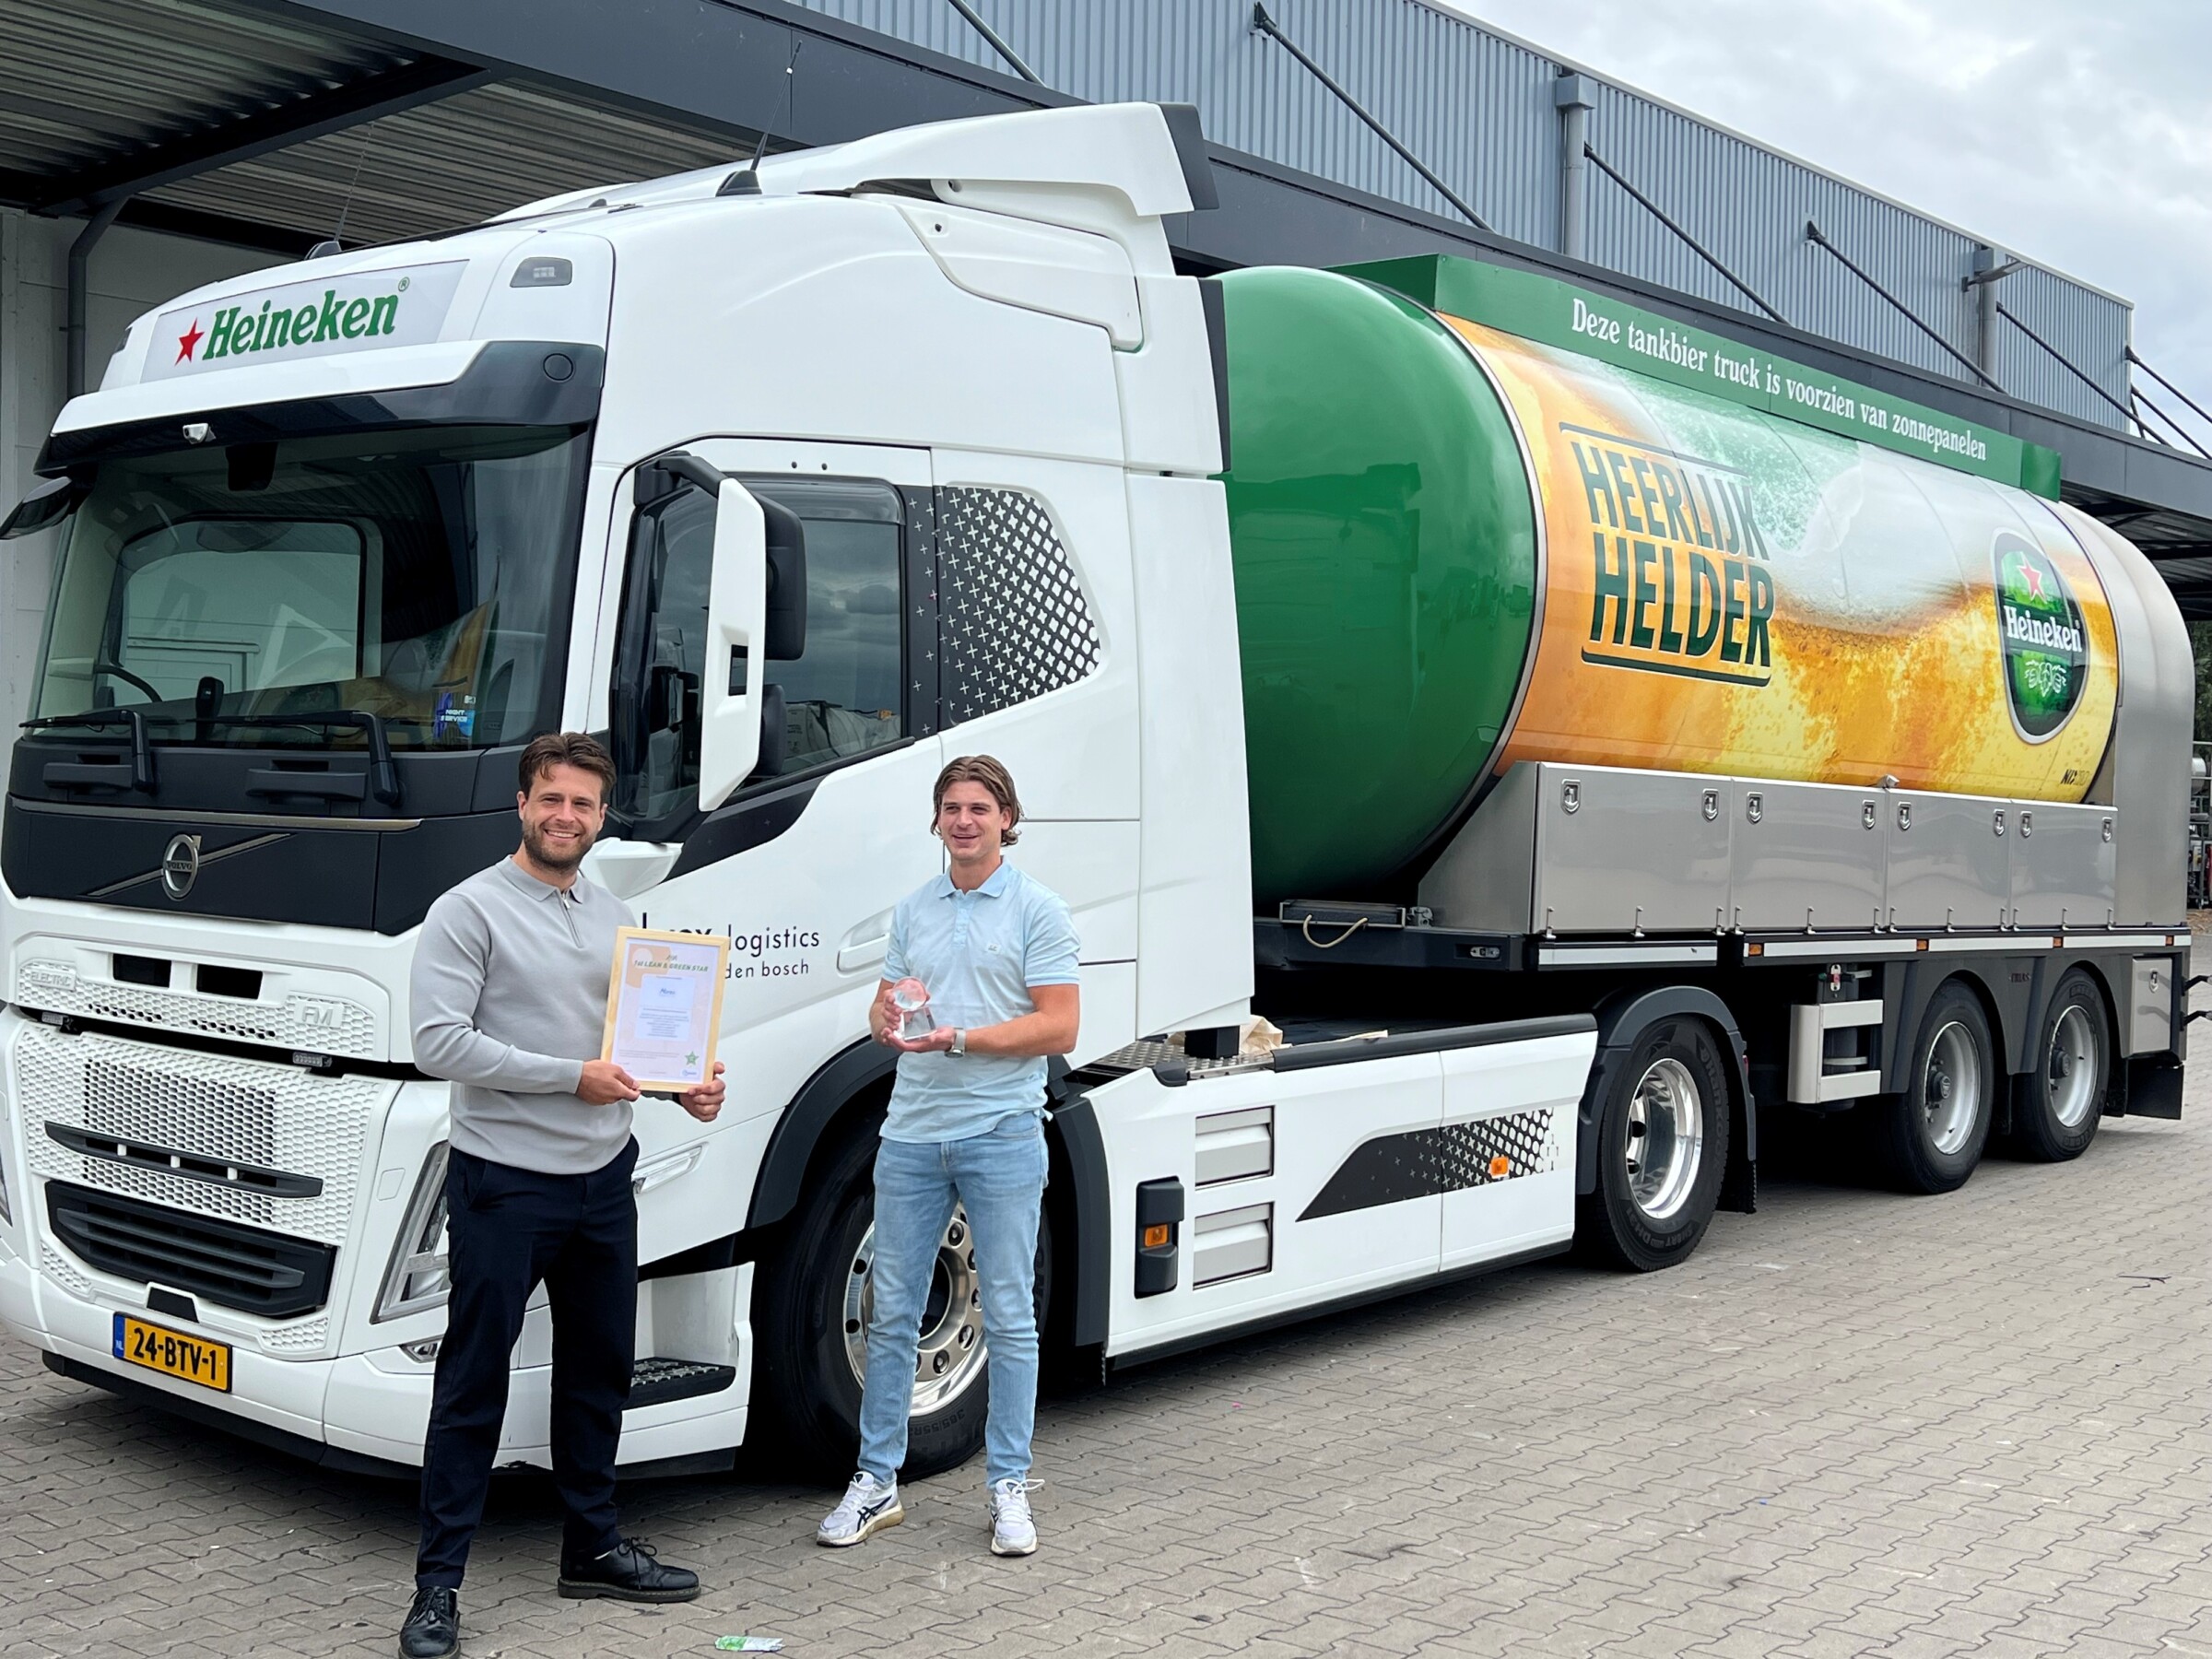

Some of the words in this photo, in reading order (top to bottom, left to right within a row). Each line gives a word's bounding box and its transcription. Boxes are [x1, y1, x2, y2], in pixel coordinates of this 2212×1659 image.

[1571, 298, 1620, 344] Deze
[1628, 321, 1708, 372] tankbier
[1713, 349, 1760, 390] truck
[1765, 363, 1781, 395] is
[1786, 378, 1855, 420] voorzien
[1860, 402, 1888, 430] van
[1892, 414, 1987, 462] zonnepanelen
[1570, 441, 1771, 561] HEERLIJK
[1589, 531, 1775, 667] HELDER
[2003, 605, 2083, 653] Heineken
[166, 860, 193, 870] VOLVO
[728, 924, 820, 958] logistics
[30, 971, 72, 987] ELECTRIC
[691, 964, 709, 972] STAR
[761, 958, 809, 978] bosch
[134, 1326, 217, 1382] 24-BTV-1
